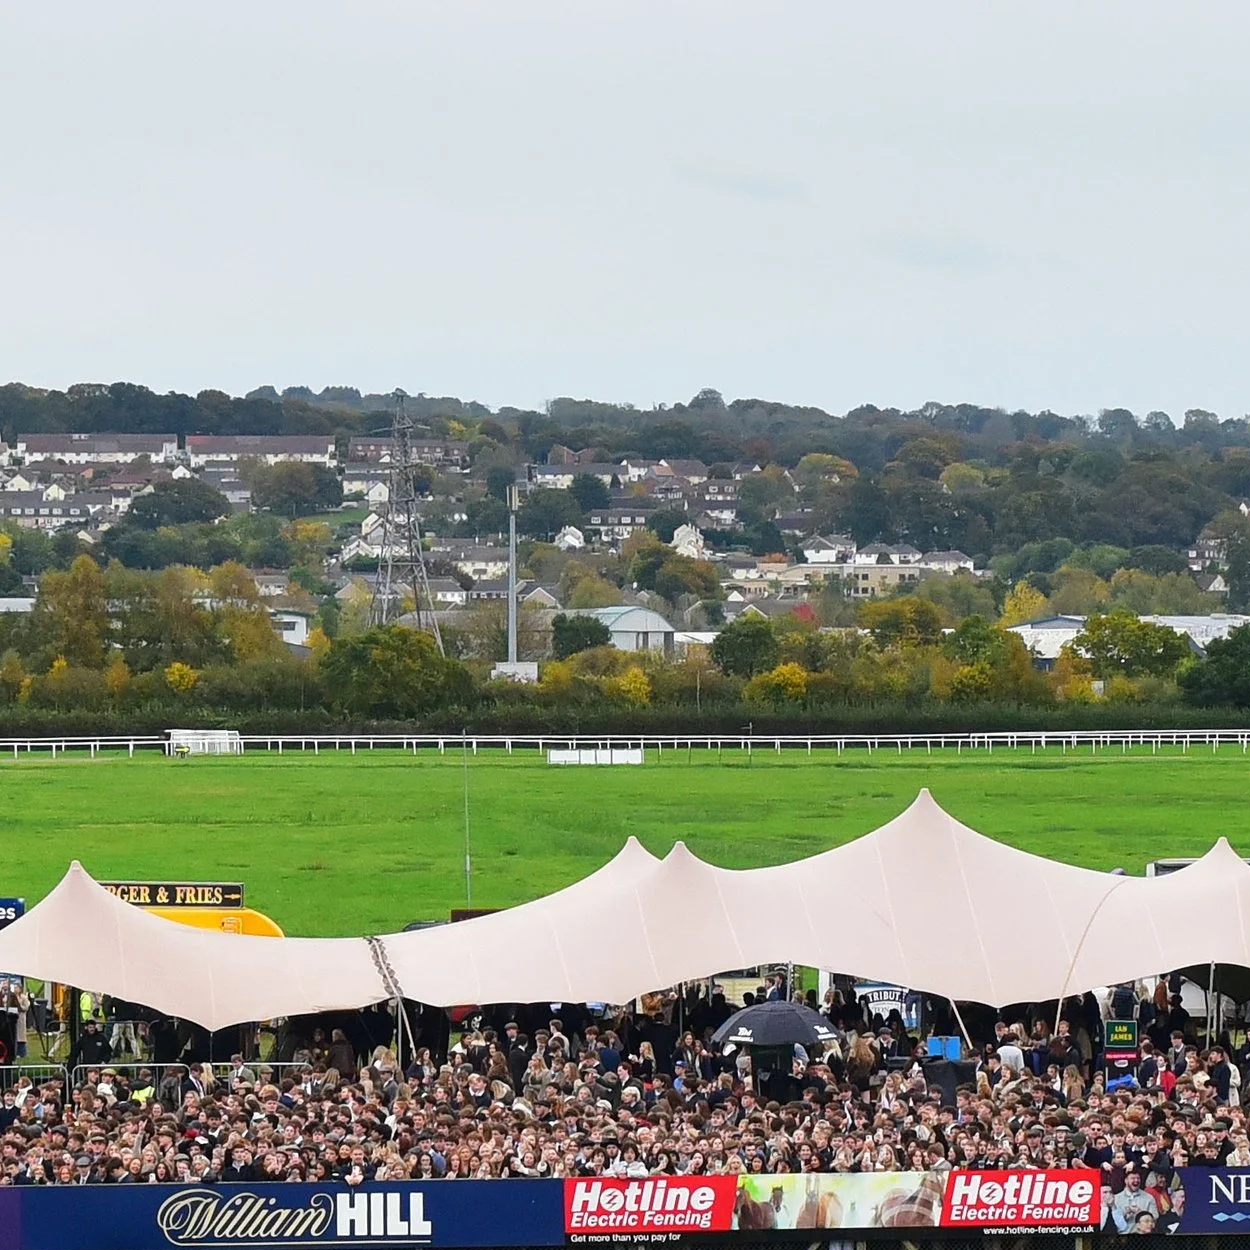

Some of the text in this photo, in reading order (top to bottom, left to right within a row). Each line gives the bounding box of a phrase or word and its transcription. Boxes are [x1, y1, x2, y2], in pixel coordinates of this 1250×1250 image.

[104, 885, 223, 905] RGER & FRIES
[867, 990, 902, 1002] TRIBUT
[571, 1180, 716, 1212] Hotline
[951, 1174, 1094, 1206] Hotline
[157, 1189, 432, 1240] William HILL
[571, 1210, 712, 1228] Electric Fencing
[951, 1203, 1091, 1222] Electric Fencing
[571, 1234, 586, 1243] Get
[612, 1233, 631, 1242] than
[633, 1235, 649, 1244] you
[651, 1235, 667, 1244] pay
[668, 1233, 681, 1242] for
